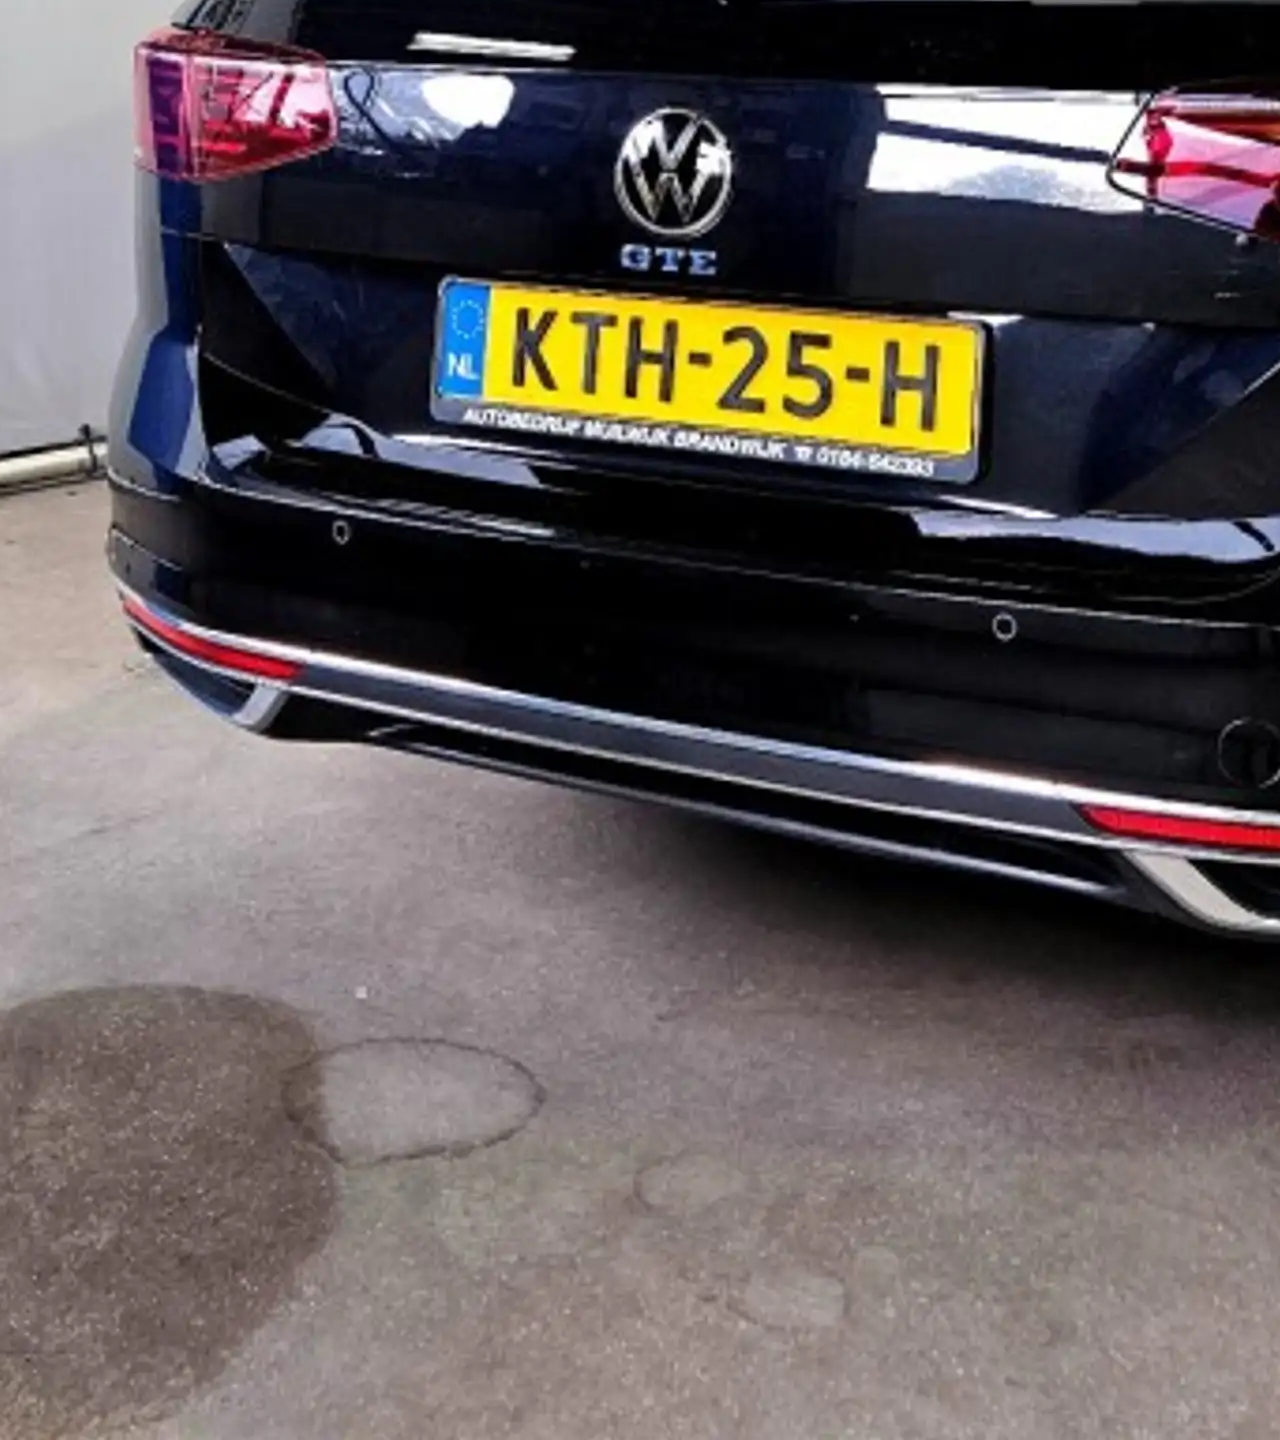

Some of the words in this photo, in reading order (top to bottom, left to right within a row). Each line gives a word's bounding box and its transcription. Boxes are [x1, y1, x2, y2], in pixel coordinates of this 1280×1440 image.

[620, 243, 717, 276] GTE
[447, 352, 480, 380] NL
[510, 306, 941, 432] KTH-25-H
[463, 408, 580, 435] AUTOBEDRIJF
[673, 429, 788, 460] BRANDWIJK
